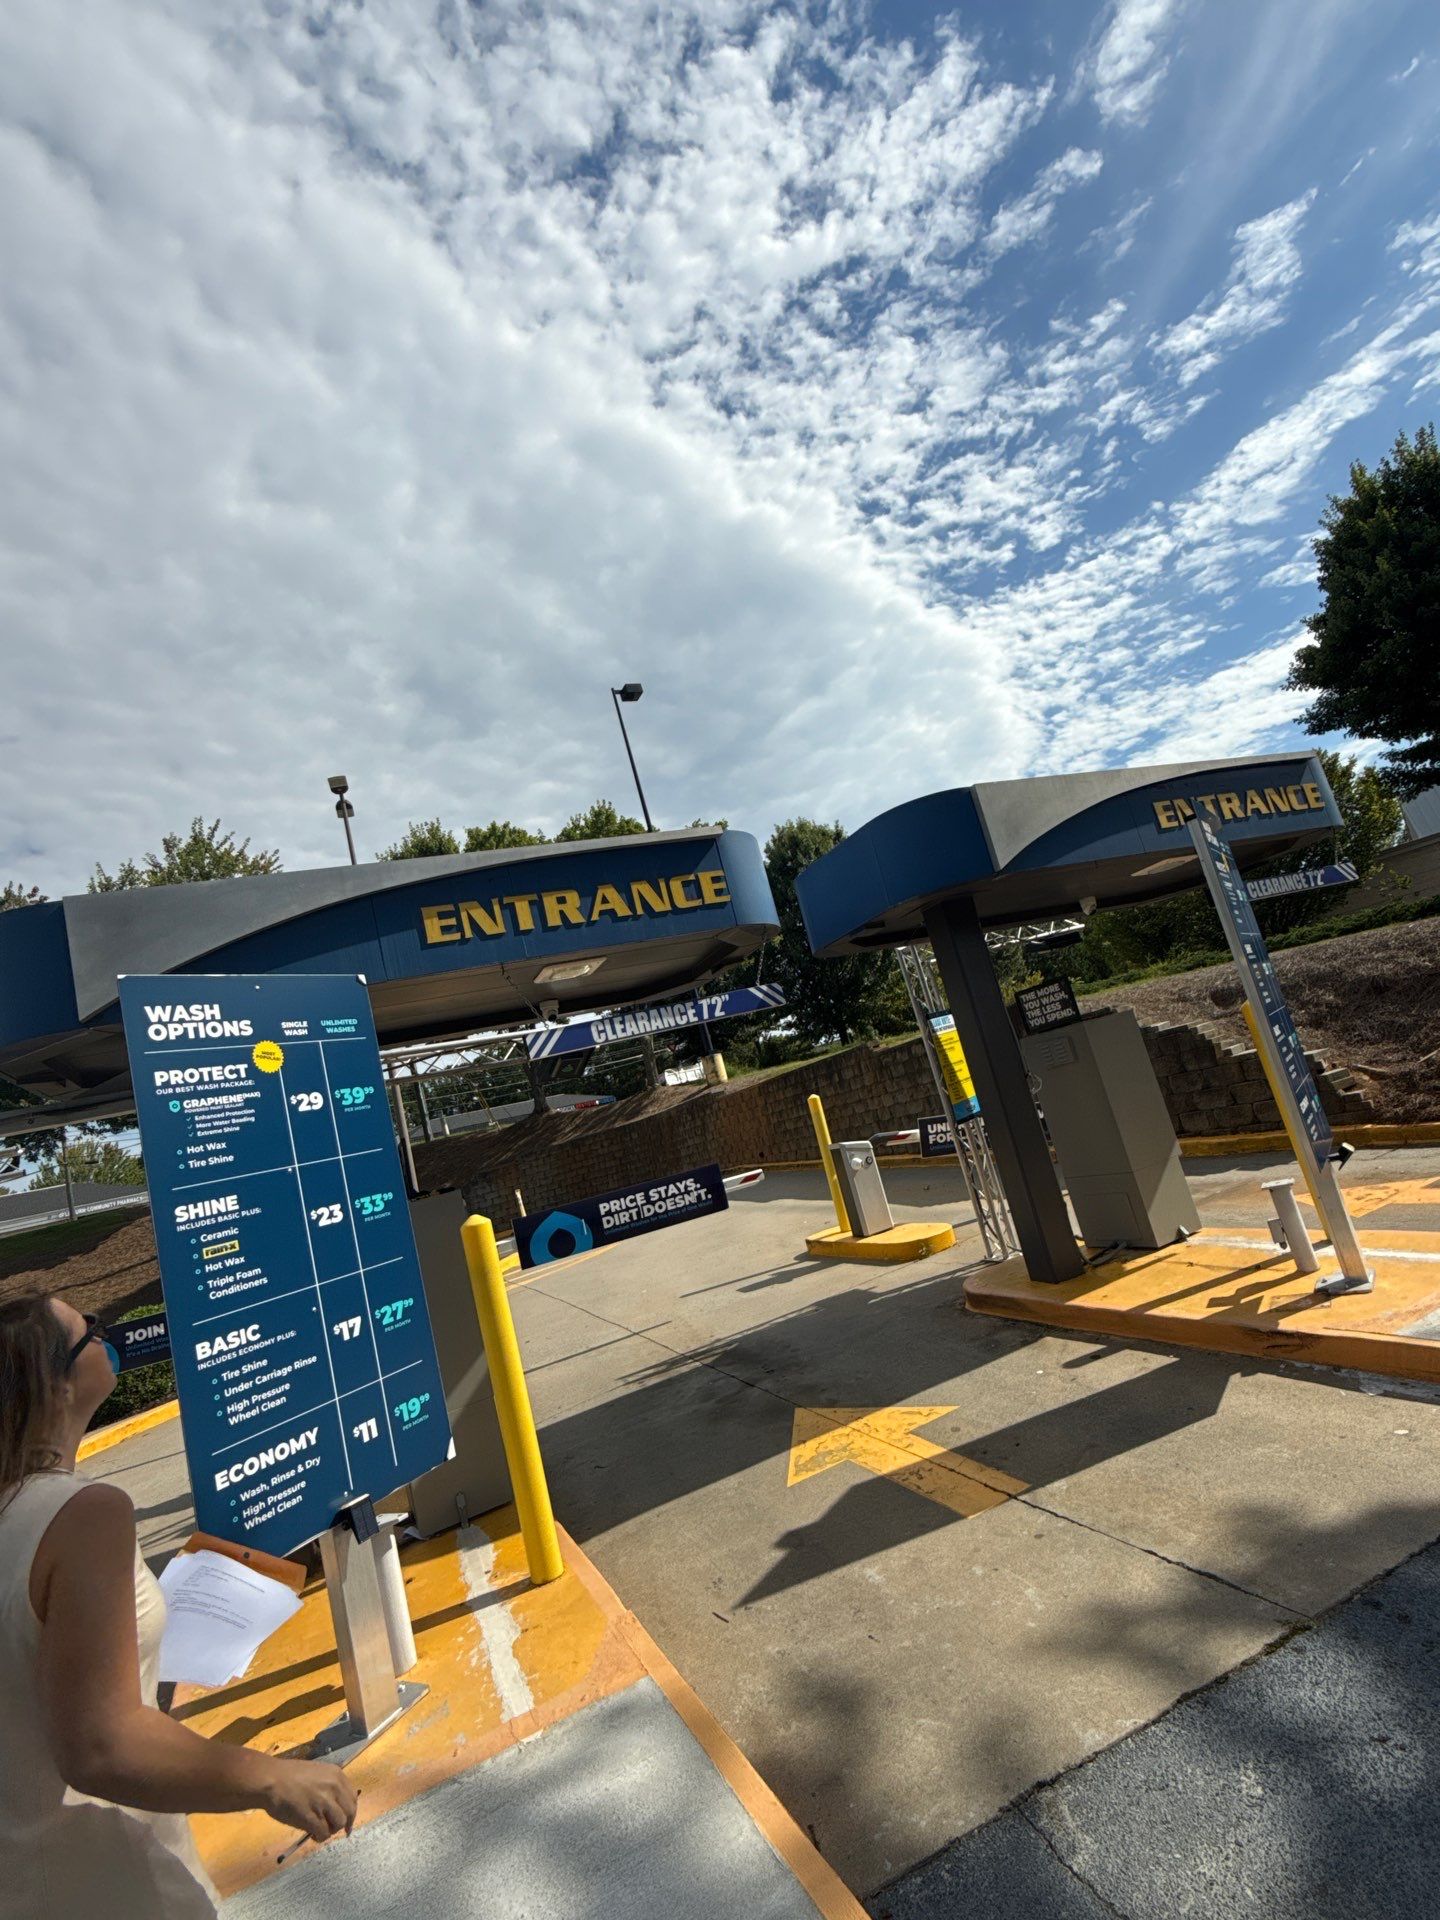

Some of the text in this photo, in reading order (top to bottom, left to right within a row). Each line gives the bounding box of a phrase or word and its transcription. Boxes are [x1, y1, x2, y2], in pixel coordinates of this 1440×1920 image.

[1153, 783, 1325, 829] ENTRANCE
[1246, 873, 1308, 898] CLEARANCE
[420, 869, 731, 944] ENTRANCE
[1020, 983, 1060, 1003] THE MORE
[144, 1004, 221, 1023] WASH
[1024, 1000, 1040, 1011] YOU
[1026, 1002, 1061, 1019] THE LESS
[147, 1020, 254, 1041] OPTIONS
[281, 1020, 308, 1029] SINGLE
[320, 1018, 358, 1027] UNLIMITED
[325, 1026, 356, 1034] WASHES
[591, 1002, 699, 1044] CLEARANCE
[1029, 1016, 1046, 1027] YOU
[154, 1064, 248, 1086] PROTECT
[220, 1080, 255, 1088] PACKAGE:
[290, 1091, 324, 1112] $29
[194, 1108, 255, 1121] Enhanced Protection
[231, 1116, 255, 1124] Beading
[197, 1125, 240, 1137] Extreme Shine
[186, 1141, 227, 1155] Hot Wax
[188, 1153, 235, 1169] Tire Shine
[599, 1178, 701, 1216] PRICE STAYS.
[174, 1194, 239, 1223] SHINE
[310, 1203, 344, 1227] $23
[374, 1211, 391, 1220] MONTH
[601, 1207, 639, 1229] DIRT
[176, 1207, 262, 1232] INCLUDES BASIC PLUS:
[200, 1227, 239, 1242] Ceramic
[205, 1256, 245, 1273] Hot Wax
[207, 1267, 262, 1288] Triple Foam
[209, 1277, 268, 1300] Conditioners
[125, 1323, 165, 1344] JOIN
[333, 1315, 362, 1341] $17
[394, 1318, 411, 1329] MONTH
[195, 1324, 261, 1361] BASIC
[197, 1330, 297, 1371] INCLUDES ECONOMY PLUS:
[221, 1359, 268, 1381] Tire Shine
[224, 1356, 317, 1397] Under Carriage Rinse
[226, 1383, 290, 1415] High Pressure
[228, 1396, 287, 1426] Wheel Clean
[353, 1417, 379, 1443] $11
[402, 1414, 430, 1431] PER MONTH
[214, 1426, 319, 1491] ECONOMY
[240, 1456, 321, 1502] Wash, Rinse & Dry
[242, 1480, 307, 1518] High Pressure
[244, 1495, 303, 1530] Wheel Clean
